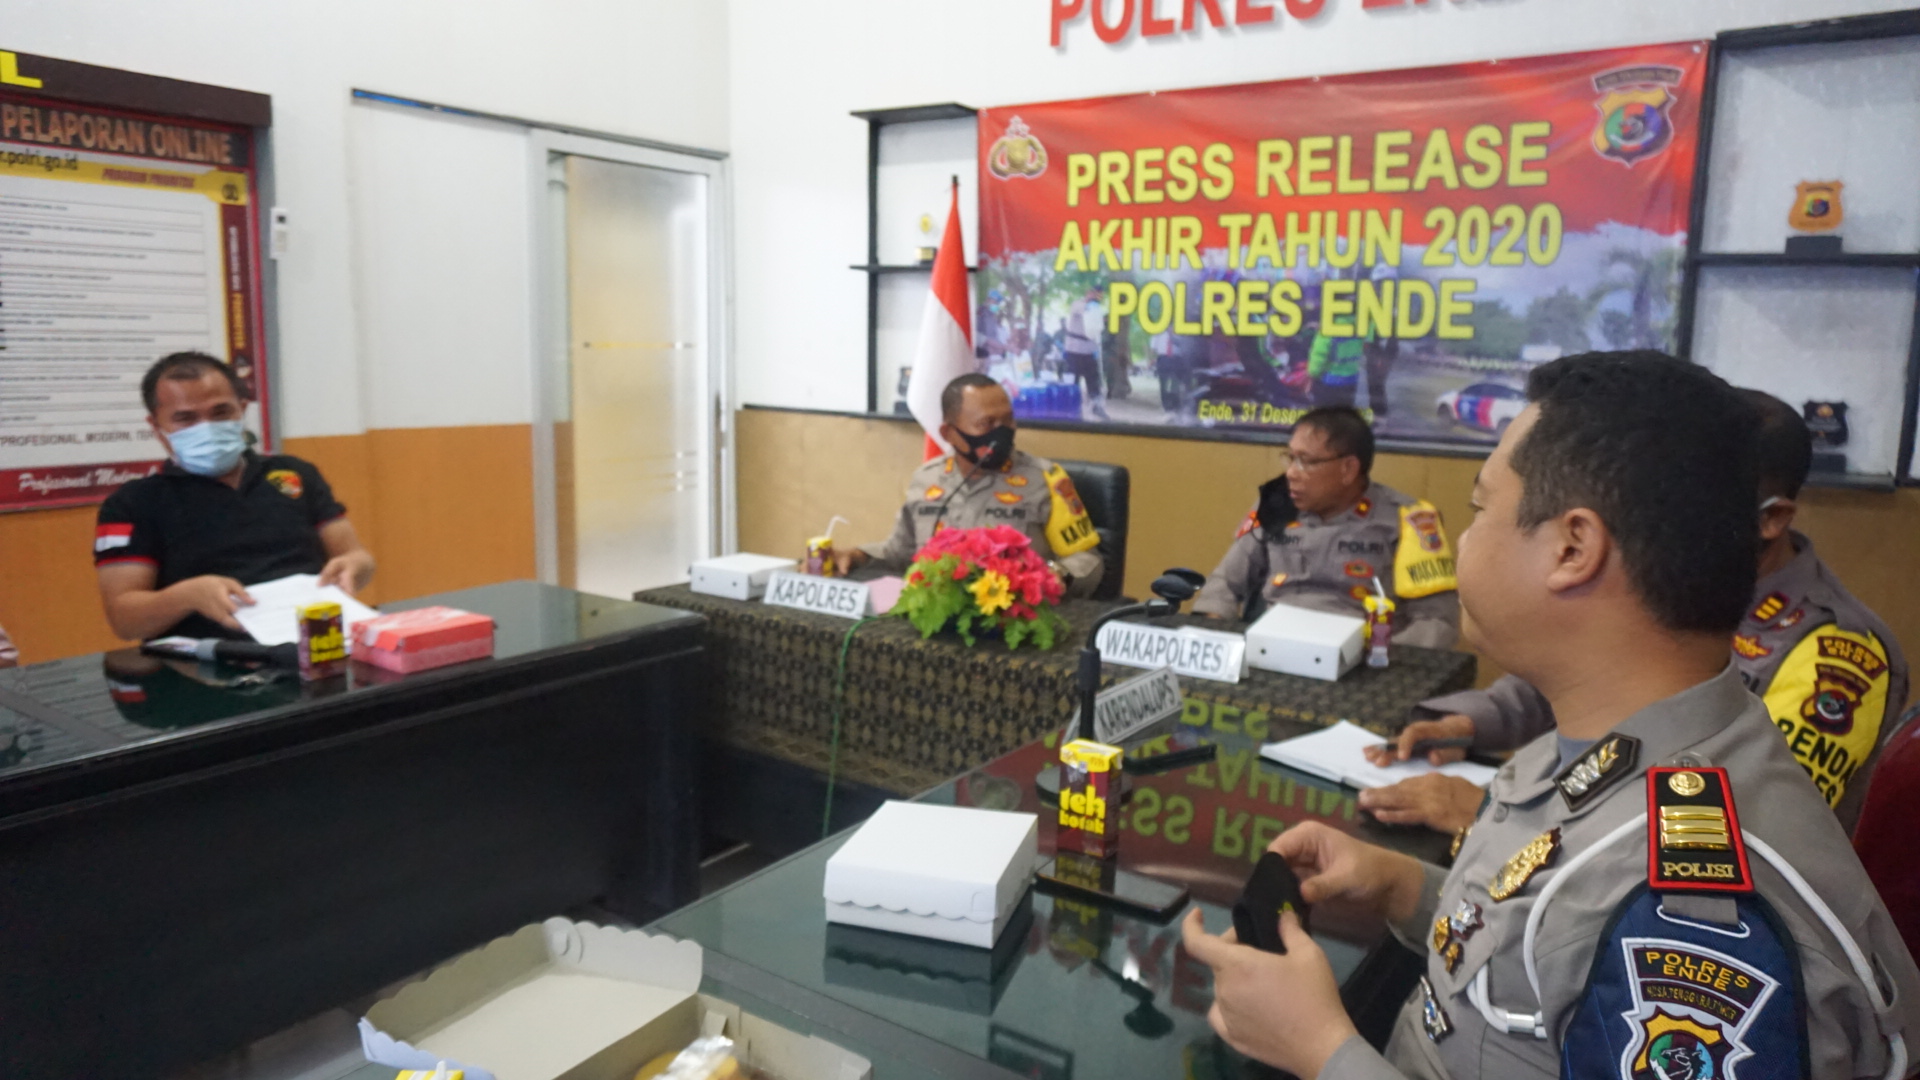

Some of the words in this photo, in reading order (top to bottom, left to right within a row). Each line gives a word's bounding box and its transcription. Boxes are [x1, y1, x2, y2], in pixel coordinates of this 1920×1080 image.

[2, 104, 146, 154] PELAPORAN
[151, 123, 232, 163] ONLINE
[1067, 142, 1235, 207] PRESS
[1256, 121, 1551, 197] RELEASE
[1054, 215, 1204, 272] AKHIR
[1217, 208, 1403, 269] TAHUN
[1421, 202, 1563, 267] 2020
[1108, 280, 1303, 337] POLRES
[1320, 279, 1477, 339] ENDE
[1198, 400, 1236, 423] Ende,
[1241, 402, 1257, 422] 31
[773, 578, 859, 613] KAPOLRES
[1105, 627, 1224, 673] WAKAPOLRES
[1097, 672, 1177, 737] KARENDALOPS
[1060, 784, 1106, 819] teh
[1662, 862, 1735, 878] POLISI
[1646, 952, 1750, 988] POLRES
[1663, 964, 1728, 991] ENDE
